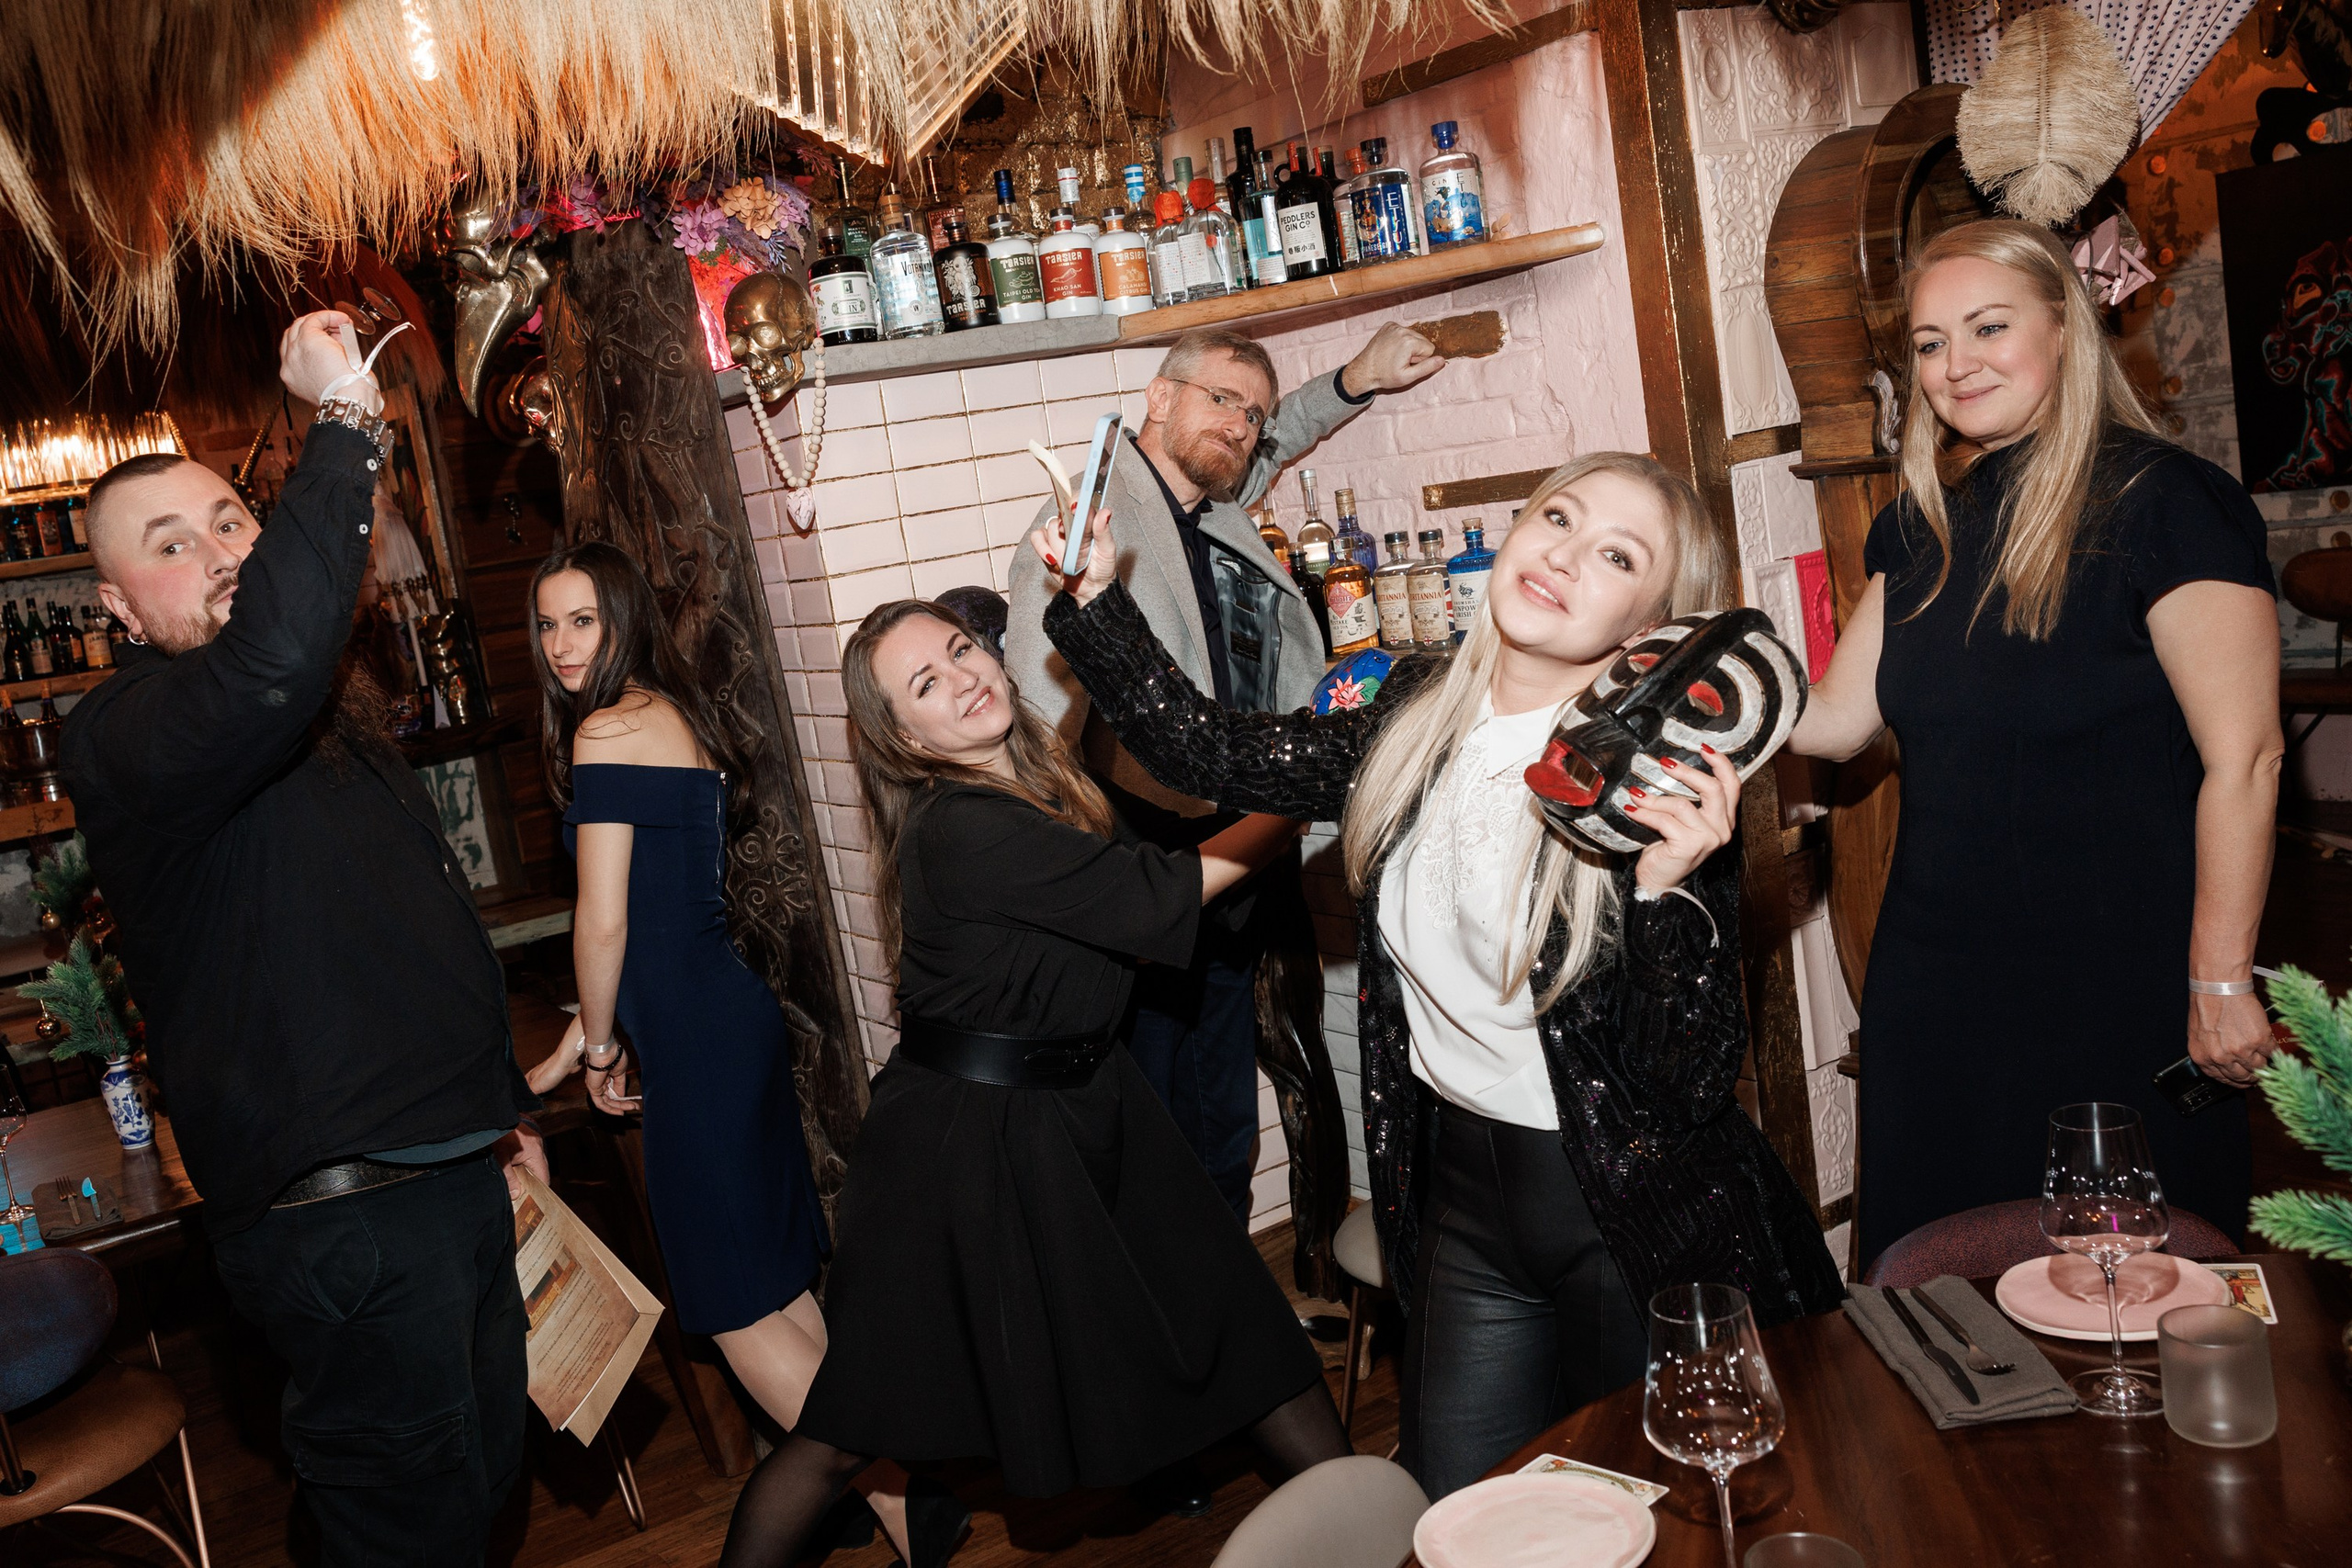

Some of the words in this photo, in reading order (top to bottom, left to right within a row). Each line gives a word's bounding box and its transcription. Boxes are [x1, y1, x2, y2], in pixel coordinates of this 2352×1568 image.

[1281, 211, 1316, 225] PEDDLERS
[1285, 223, 1298, 232] GIN
[946, 299, 986, 315] TARSER
